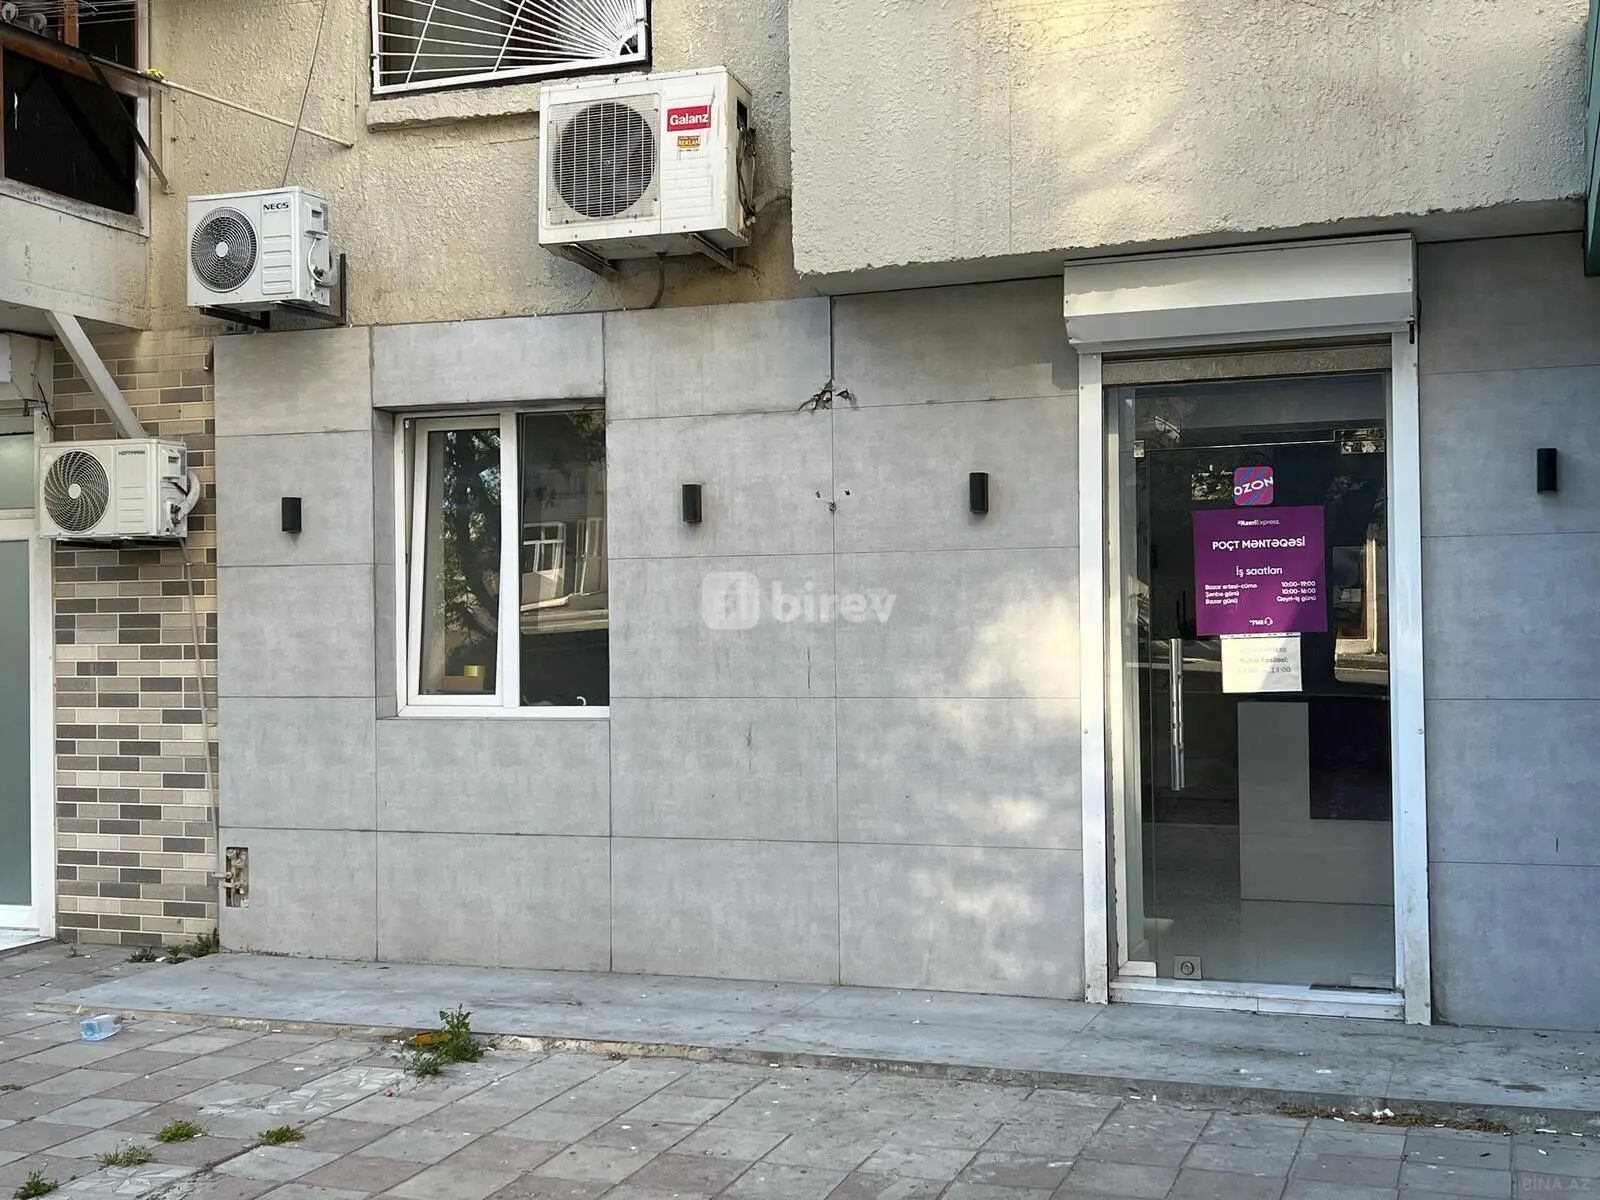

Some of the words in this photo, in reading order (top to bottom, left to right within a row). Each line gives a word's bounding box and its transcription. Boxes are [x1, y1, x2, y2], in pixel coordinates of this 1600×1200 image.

[670, 113, 709, 126] Galanz
[263, 202, 289, 211] NEOS
[1234, 477, 1274, 496] OZON
[1212, 540, 1240, 551] POÇT
[1241, 536, 1306, 549] MƏNTƏQƏSİ
[1236, 565, 1244, 577] İş
[1245, 565, 1283, 576] saatları
[1204, 591, 1224, 599] Şənbə
[1300, 594, 1317, 603] günü
